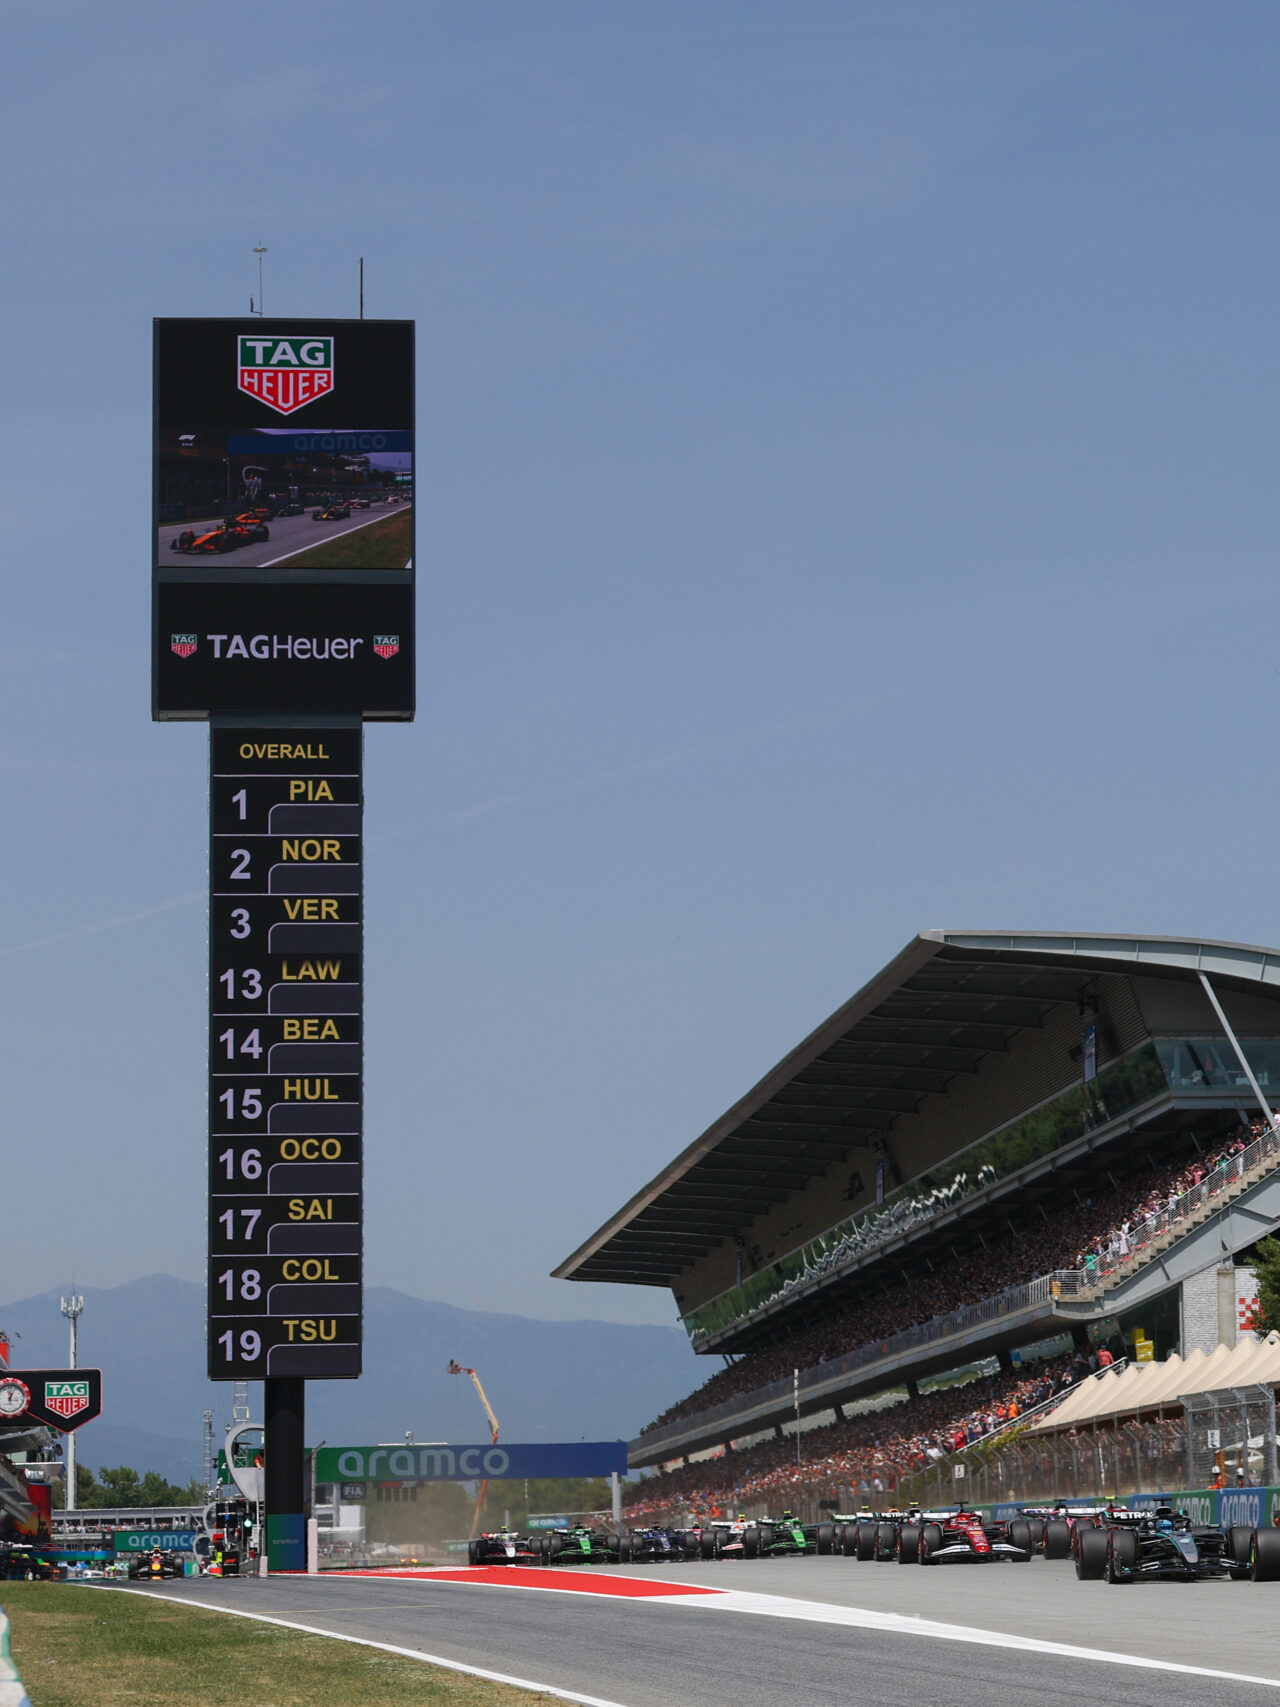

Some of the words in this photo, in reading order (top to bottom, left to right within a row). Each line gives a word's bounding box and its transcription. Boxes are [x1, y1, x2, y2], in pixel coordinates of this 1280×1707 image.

[246, 341, 325, 365] TAG
[244, 372, 328, 409] HEUER
[294, 433, 387, 451] aramco
[174, 635, 195, 643] TAG
[376, 637, 397, 645] TAG
[239, 744, 330, 759] OVERALL
[232, 789, 247, 820] 1
[289, 780, 334, 801] PIA
[229, 849, 251, 879] 2
[282, 839, 342, 861] NOR
[229, 908, 251, 939] 3
[283, 899, 339, 920] VER
[219, 968, 263, 1000] 13
[282, 960, 342, 980] LAW
[219, 1028, 263, 1060] 14
[283, 1019, 340, 1040] BEA
[219, 1088, 263, 1120] 15
[283, 1079, 339, 1100] HUL
[219, 1148, 263, 1180] 16
[280, 1138, 342, 1160] OCO
[218, 1209, 262, 1240] 17
[288, 1199, 333, 1220] SAI
[218, 1269, 262, 1301] 18
[282, 1259, 339, 1281] COL
[218, 1330, 262, 1361] 19
[283, 1319, 337, 1341] TSU
[47, 1398, 87, 1415] HEUER
[49, 1384, 85, 1396] TAG
[337, 1448, 510, 1478] aramco
[344, 1486, 362, 1496] FIA
[1221, 1494, 1259, 1528] aramco
